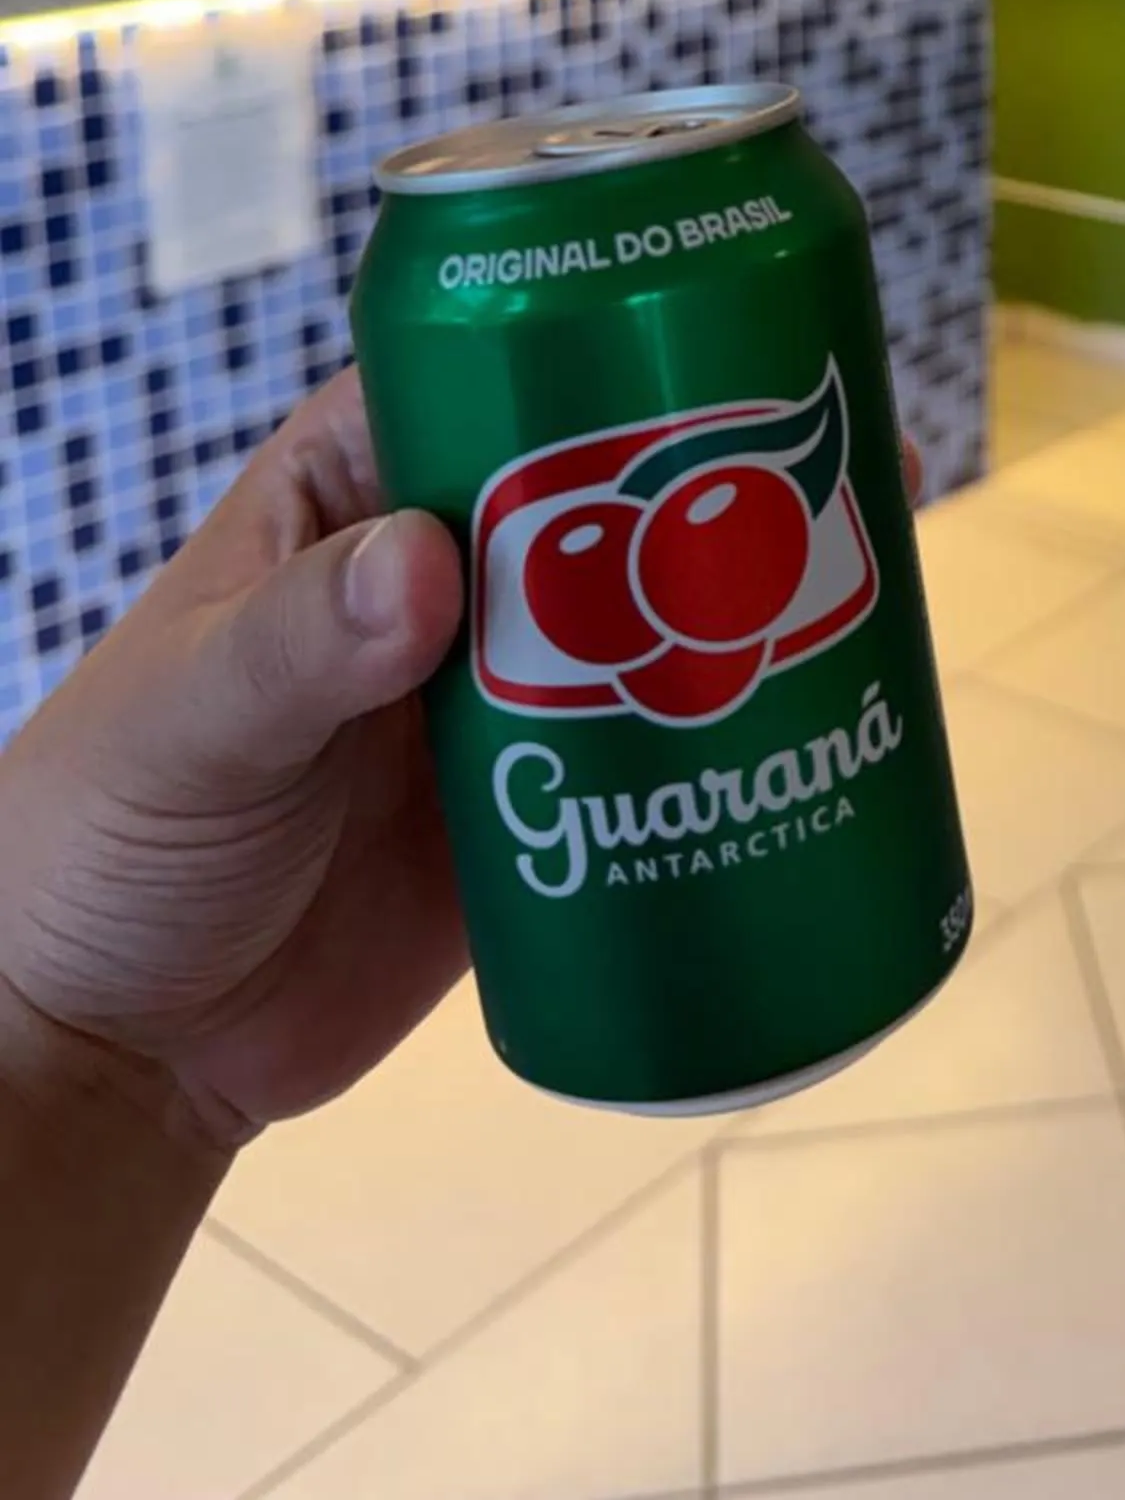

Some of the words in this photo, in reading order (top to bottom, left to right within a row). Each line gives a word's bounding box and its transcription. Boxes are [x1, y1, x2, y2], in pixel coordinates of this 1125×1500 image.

[437, 238, 612, 290] ORIGINAL
[614, 225, 674, 265] DO
[676, 195, 793, 250] BRASIL
[492, 680, 903, 899] Guaraná
[605, 795, 857, 887] ANTARCTICA
